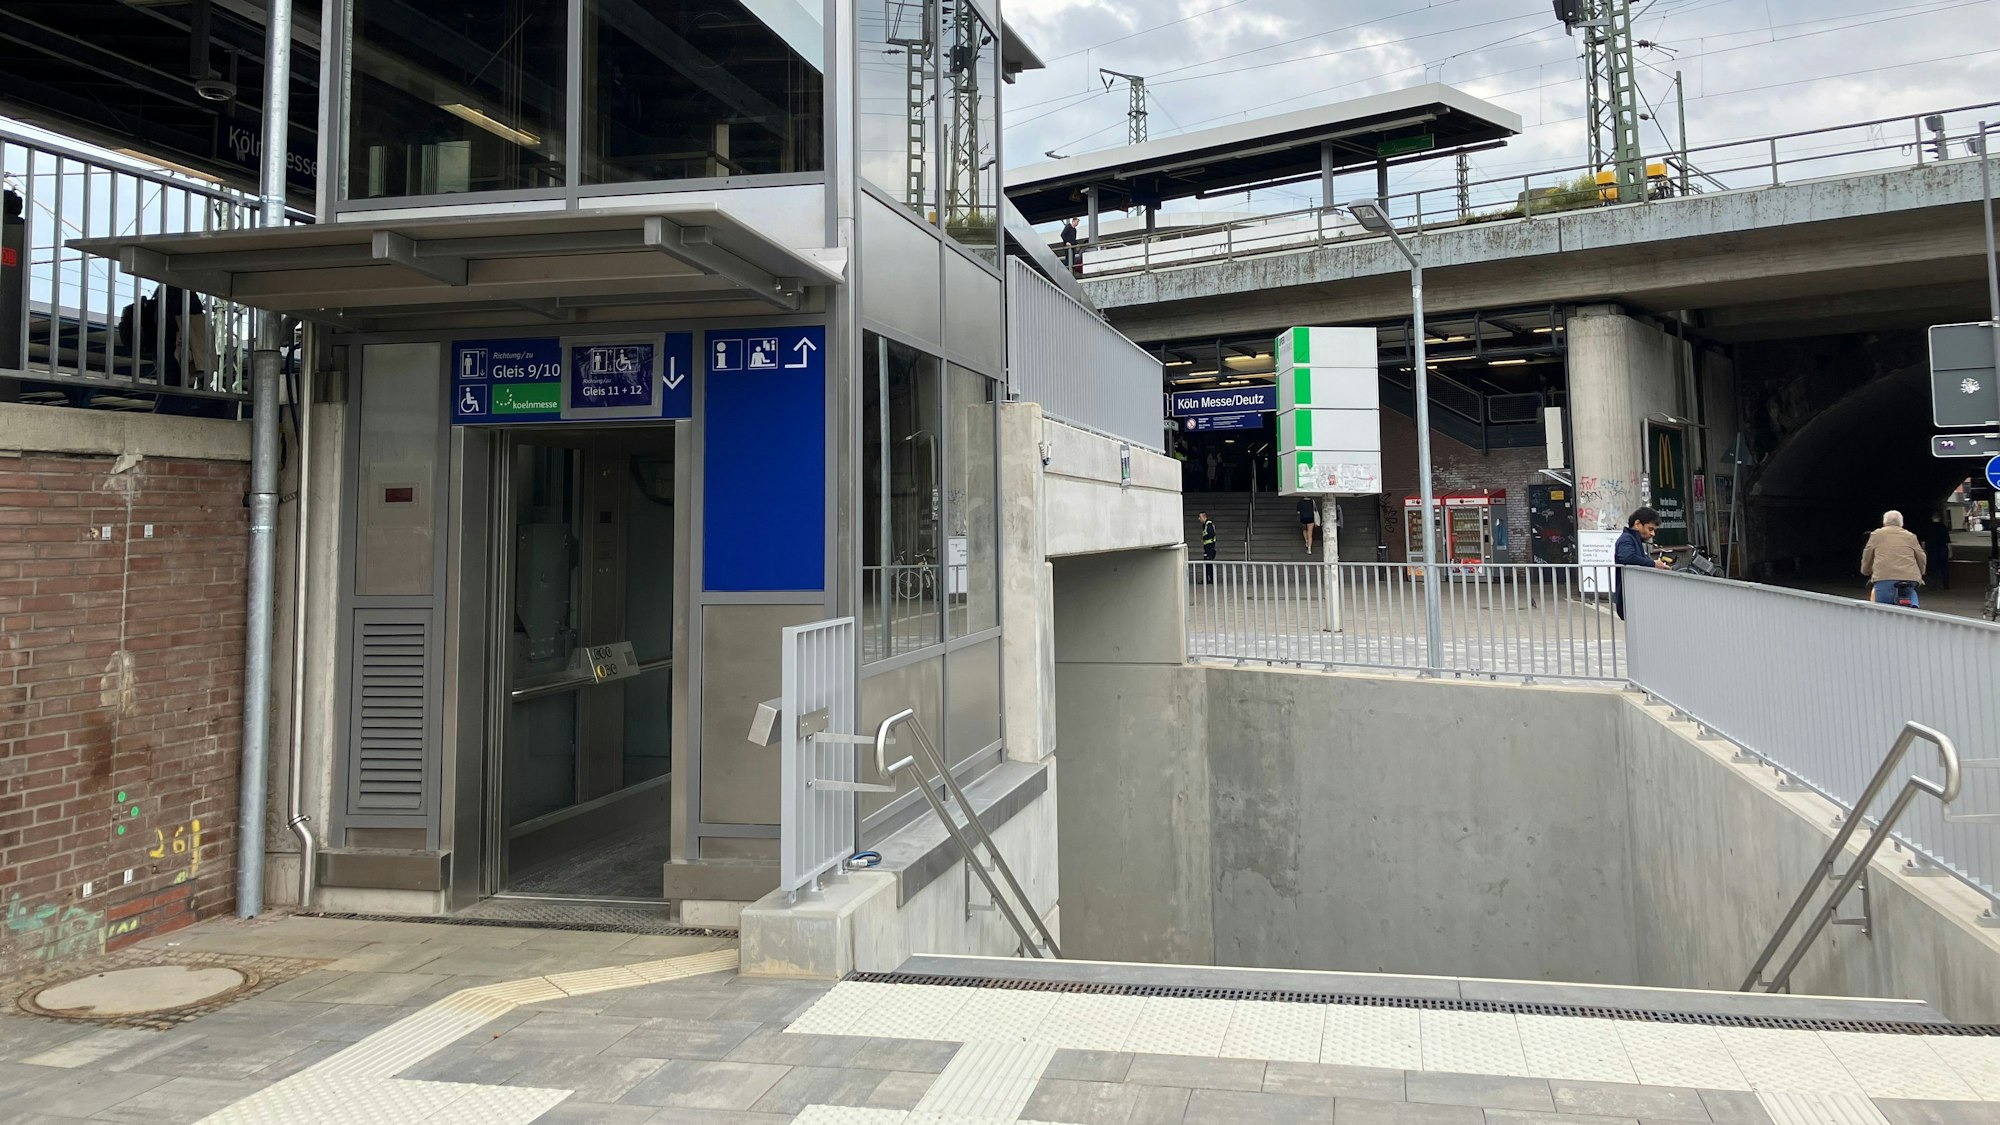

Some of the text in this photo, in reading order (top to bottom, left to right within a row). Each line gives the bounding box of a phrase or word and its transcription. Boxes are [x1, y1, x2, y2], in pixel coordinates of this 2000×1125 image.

[286, 151, 318, 178] esse
[493, 363, 561, 379] Gleis 9/10
[583, 386, 605, 396] Gleis
[608, 385, 619, 395] 11
[630, 384, 642, 395] 12
[512, 400, 558, 409] koelnmesse
[1178, 394, 1265, 410] Köln Messe/Deutz
